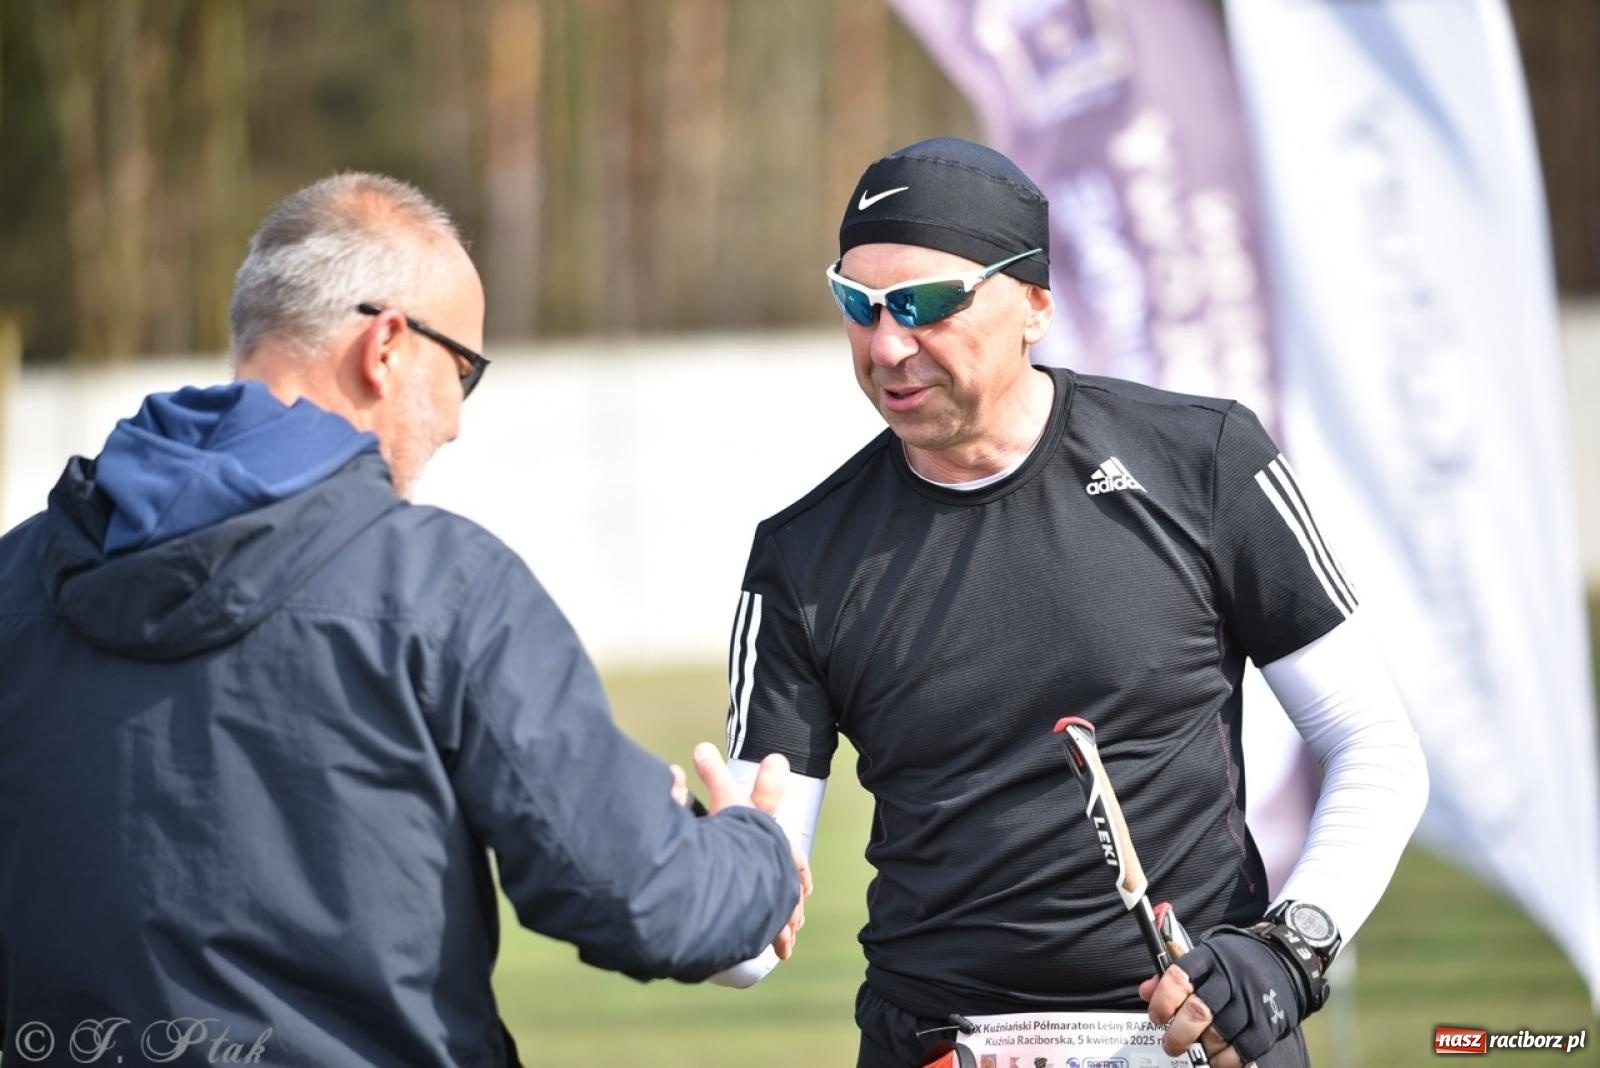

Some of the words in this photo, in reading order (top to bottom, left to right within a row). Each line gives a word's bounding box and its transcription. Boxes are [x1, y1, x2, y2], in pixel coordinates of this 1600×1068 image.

[1086, 475, 1143, 495] adida
[1094, 817, 1118, 866] LEKI
[983, 1021, 1032, 1033] Kuźniański
[1033, 1020, 1096, 1031] Półmaraton
[1097, 1021, 1124, 1032] Leśny
[985, 1036, 1016, 1046] Kuźnia
[1017, 1035, 1076, 1046] Raciborska,
[1078, 1036, 1085, 1045] 5
[1086, 1035, 1129, 1045] kwietnia
[1130, 1035, 1156, 1045] 2025
